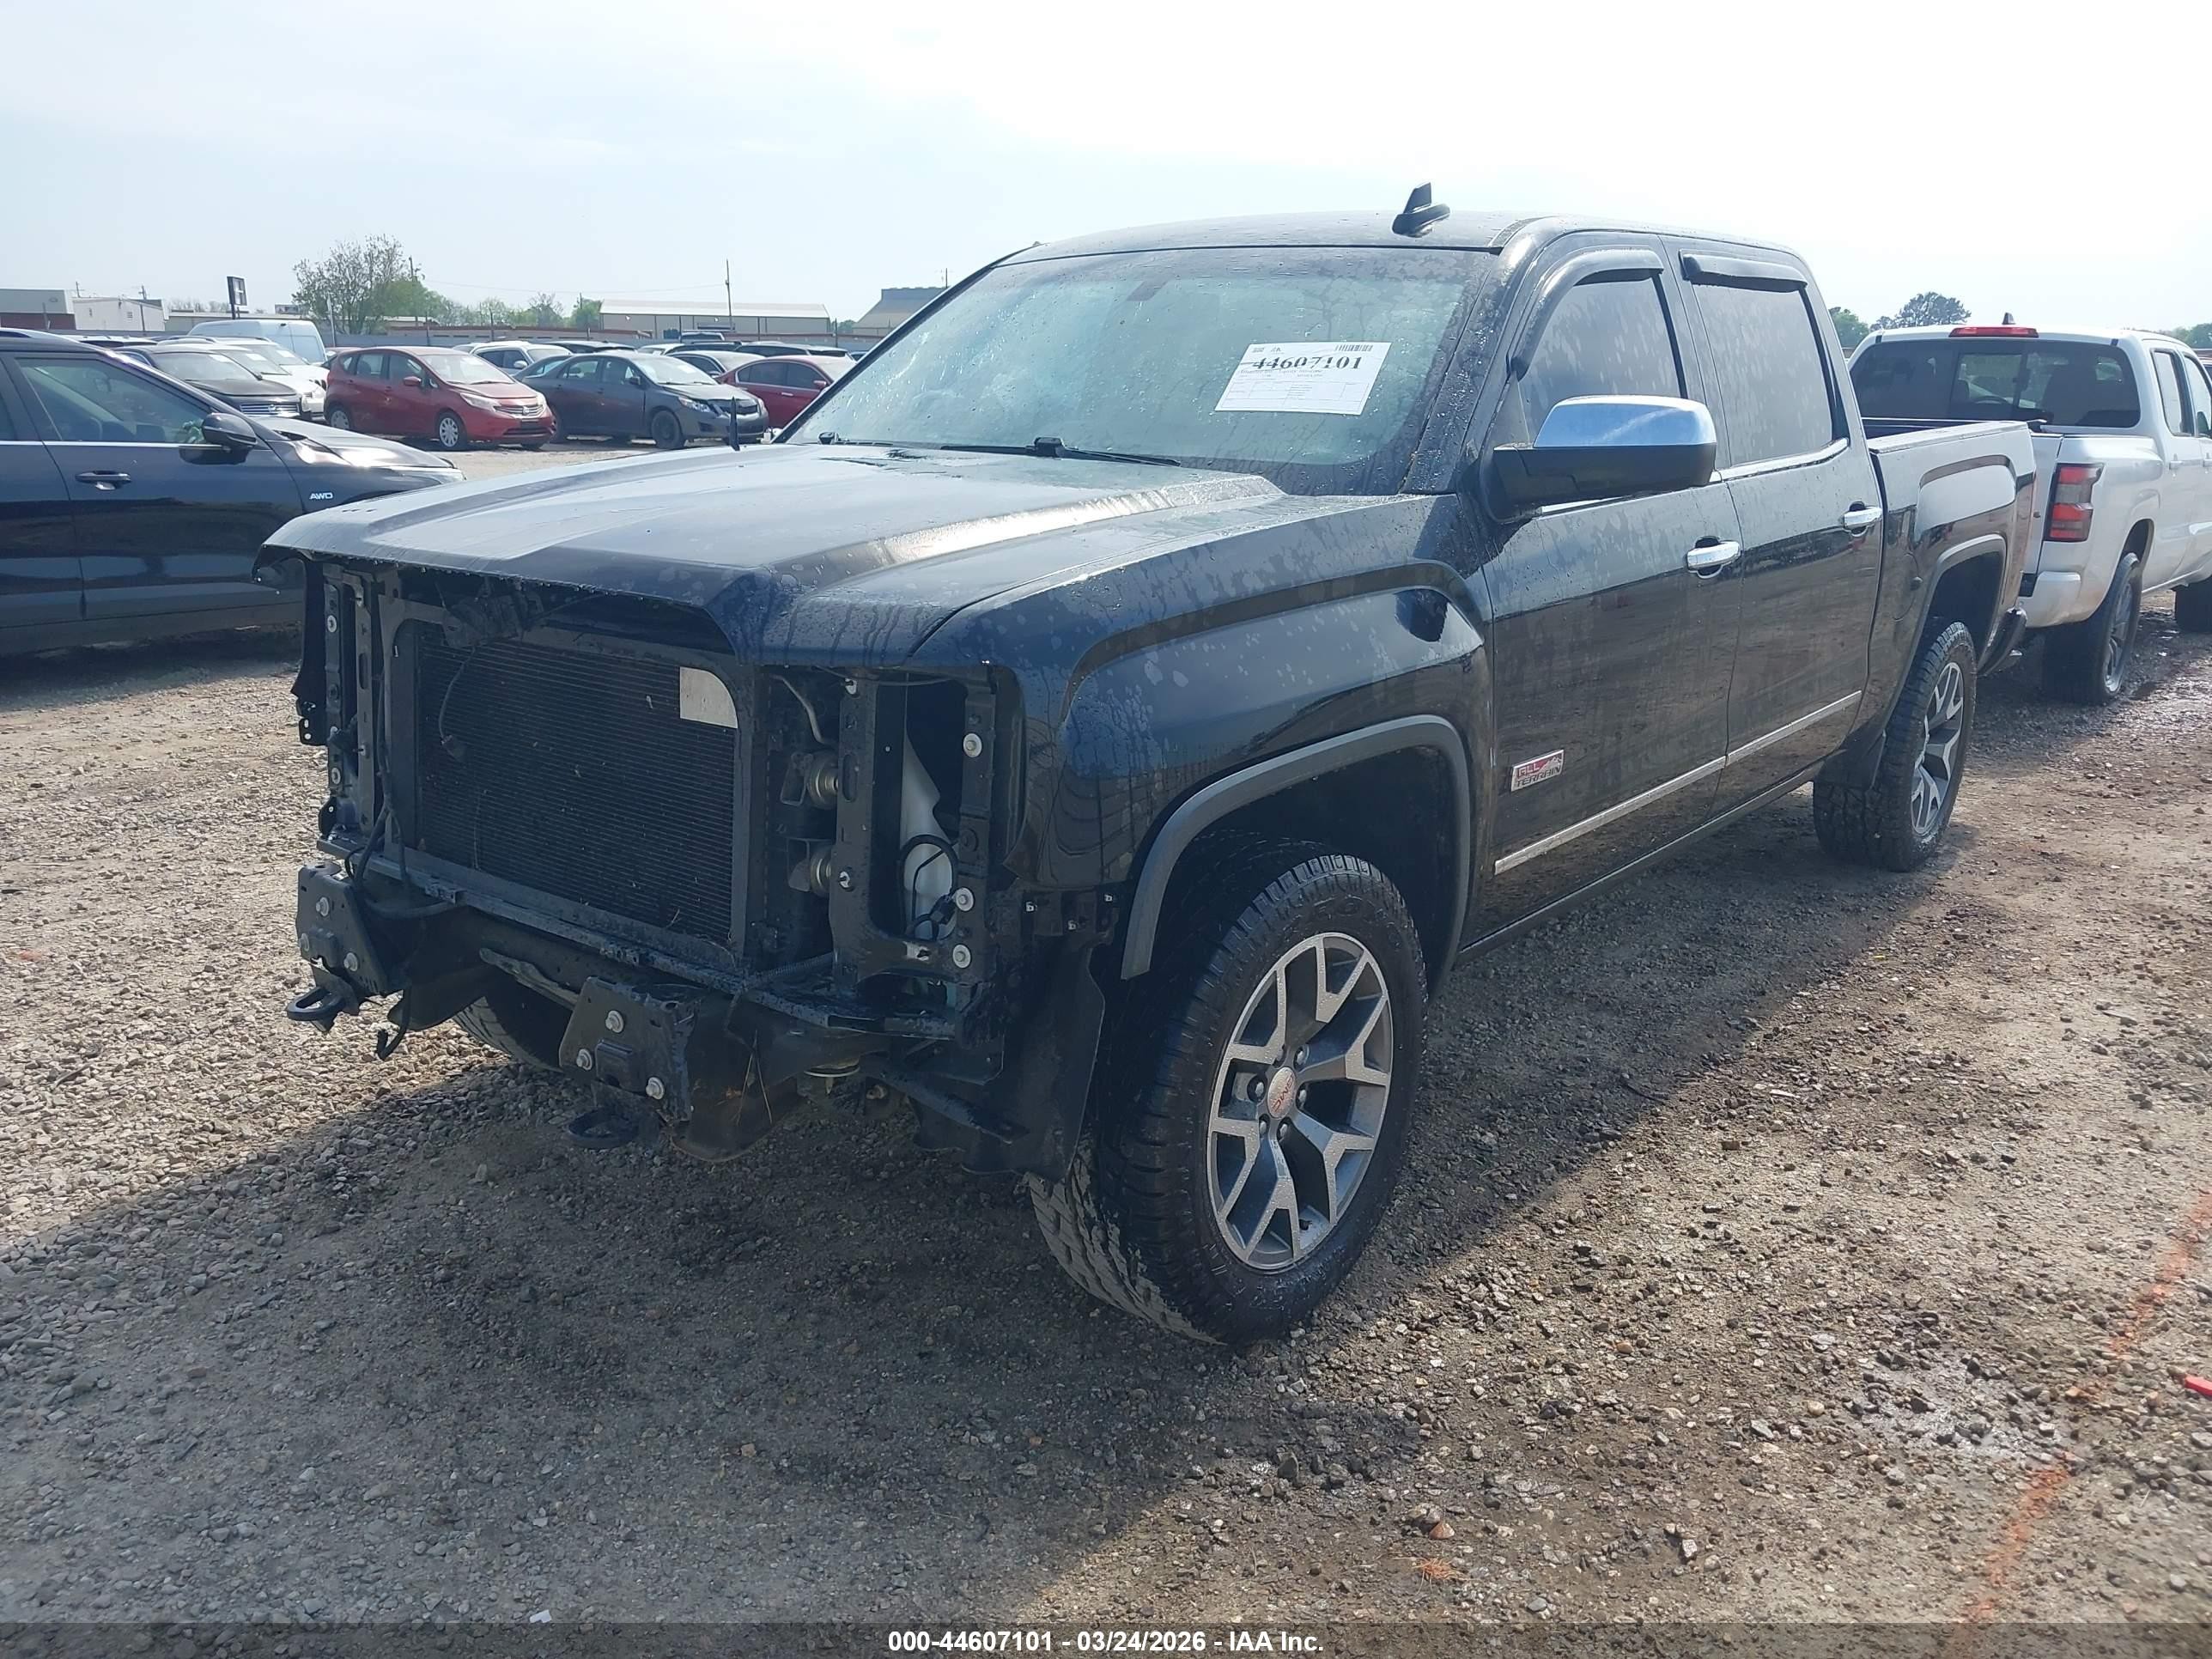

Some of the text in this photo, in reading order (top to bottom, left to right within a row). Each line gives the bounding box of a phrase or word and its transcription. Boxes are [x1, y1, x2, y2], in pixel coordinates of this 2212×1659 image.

[1252, 356, 1362, 369] 44607101
[1517, 766, 1559, 787] TERRAIN
[1518, 762, 1540, 777] ALL
[1272, 1073, 1293, 1113] GMC
